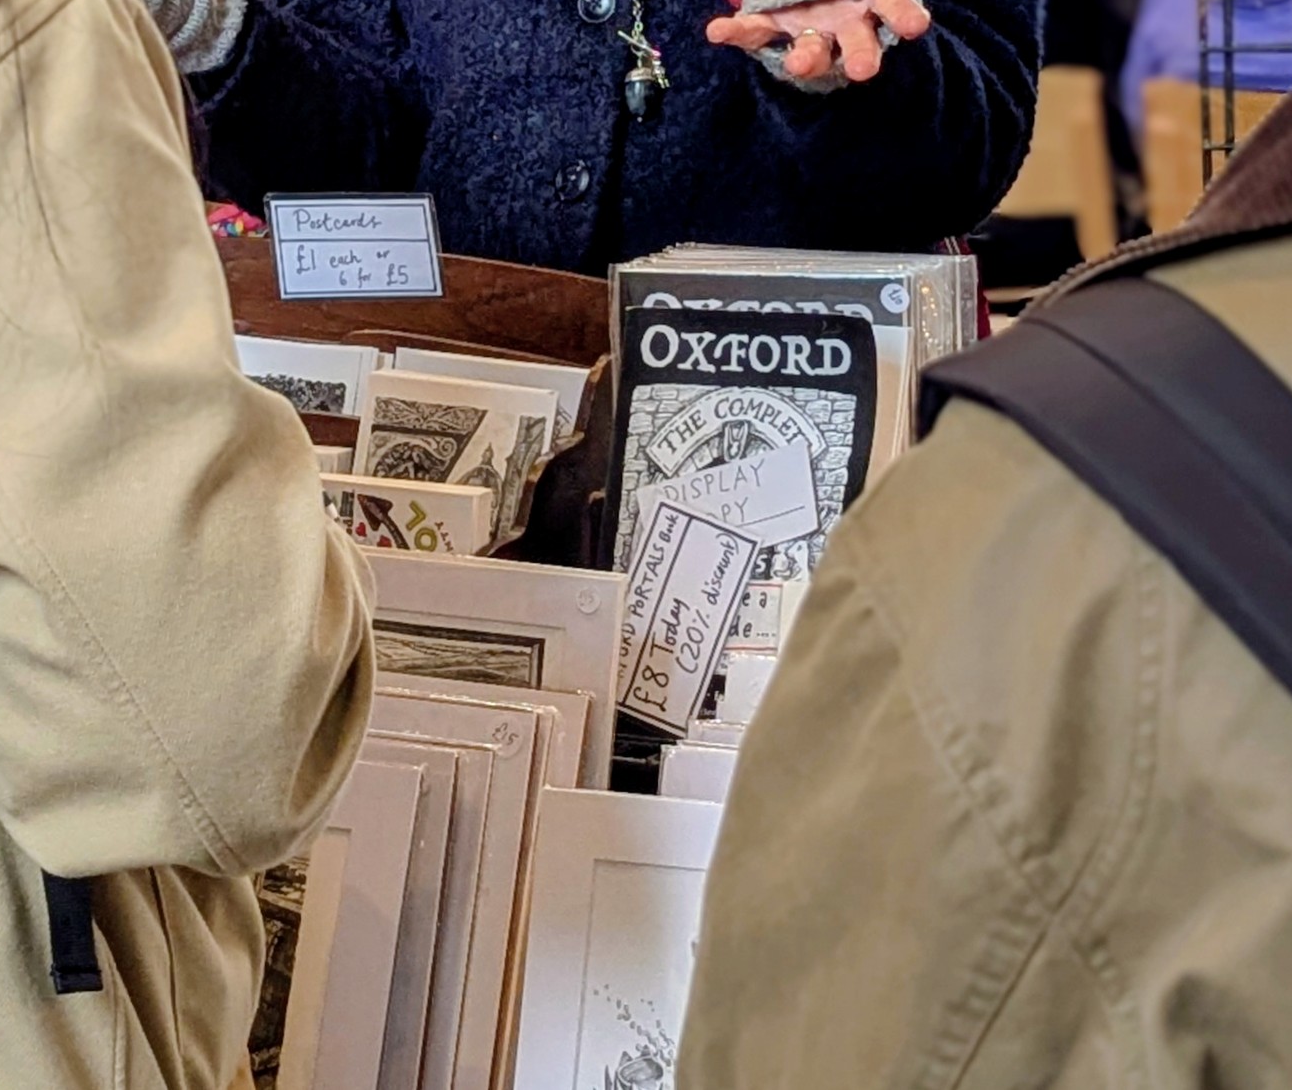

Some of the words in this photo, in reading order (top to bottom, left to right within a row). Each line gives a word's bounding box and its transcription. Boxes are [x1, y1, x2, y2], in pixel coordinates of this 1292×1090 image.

[293, 208, 382, 232] Postcards
[296, 244, 316, 275] £1
[329, 249, 362, 268] each
[377, 249, 390, 259] or
[338, 271, 348, 286] 6
[358, 267, 372, 288] for
[386, 263, 409, 286] £5
[640, 324, 852, 376] OXFORD
[658, 411, 708, 455] THE
[714, 397, 806, 445] COMPLET
[663, 458, 765, 502] DISPLAY
[628, 544, 664, 618] PORTALS
[676, 609, 710, 674] (20%
[701, 532, 739, 606] discount)
[650, 598, 690, 658] Today
